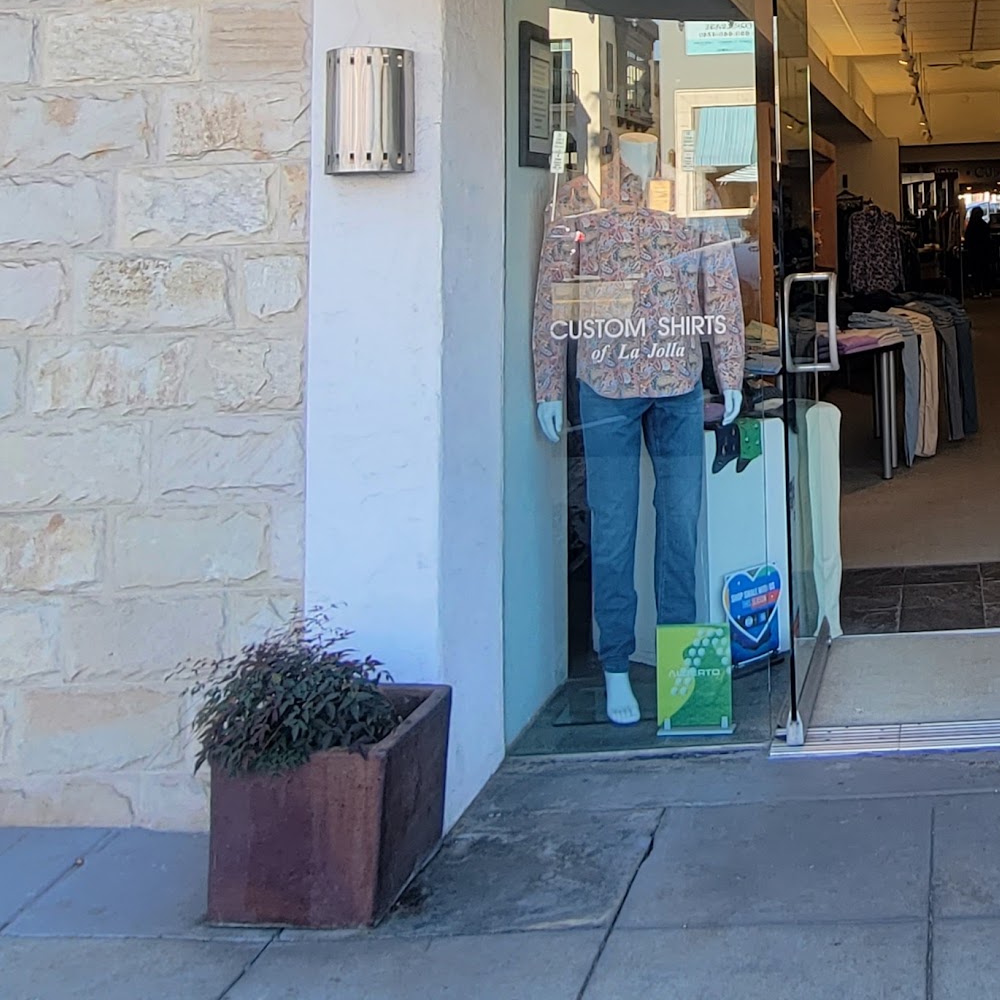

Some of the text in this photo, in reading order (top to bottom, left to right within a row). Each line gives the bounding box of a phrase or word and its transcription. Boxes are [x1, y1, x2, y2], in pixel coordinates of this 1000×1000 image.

[550, 315, 727, 340] CUSTOM SHIRTS
[591, 343, 685, 363] of La Jolla
